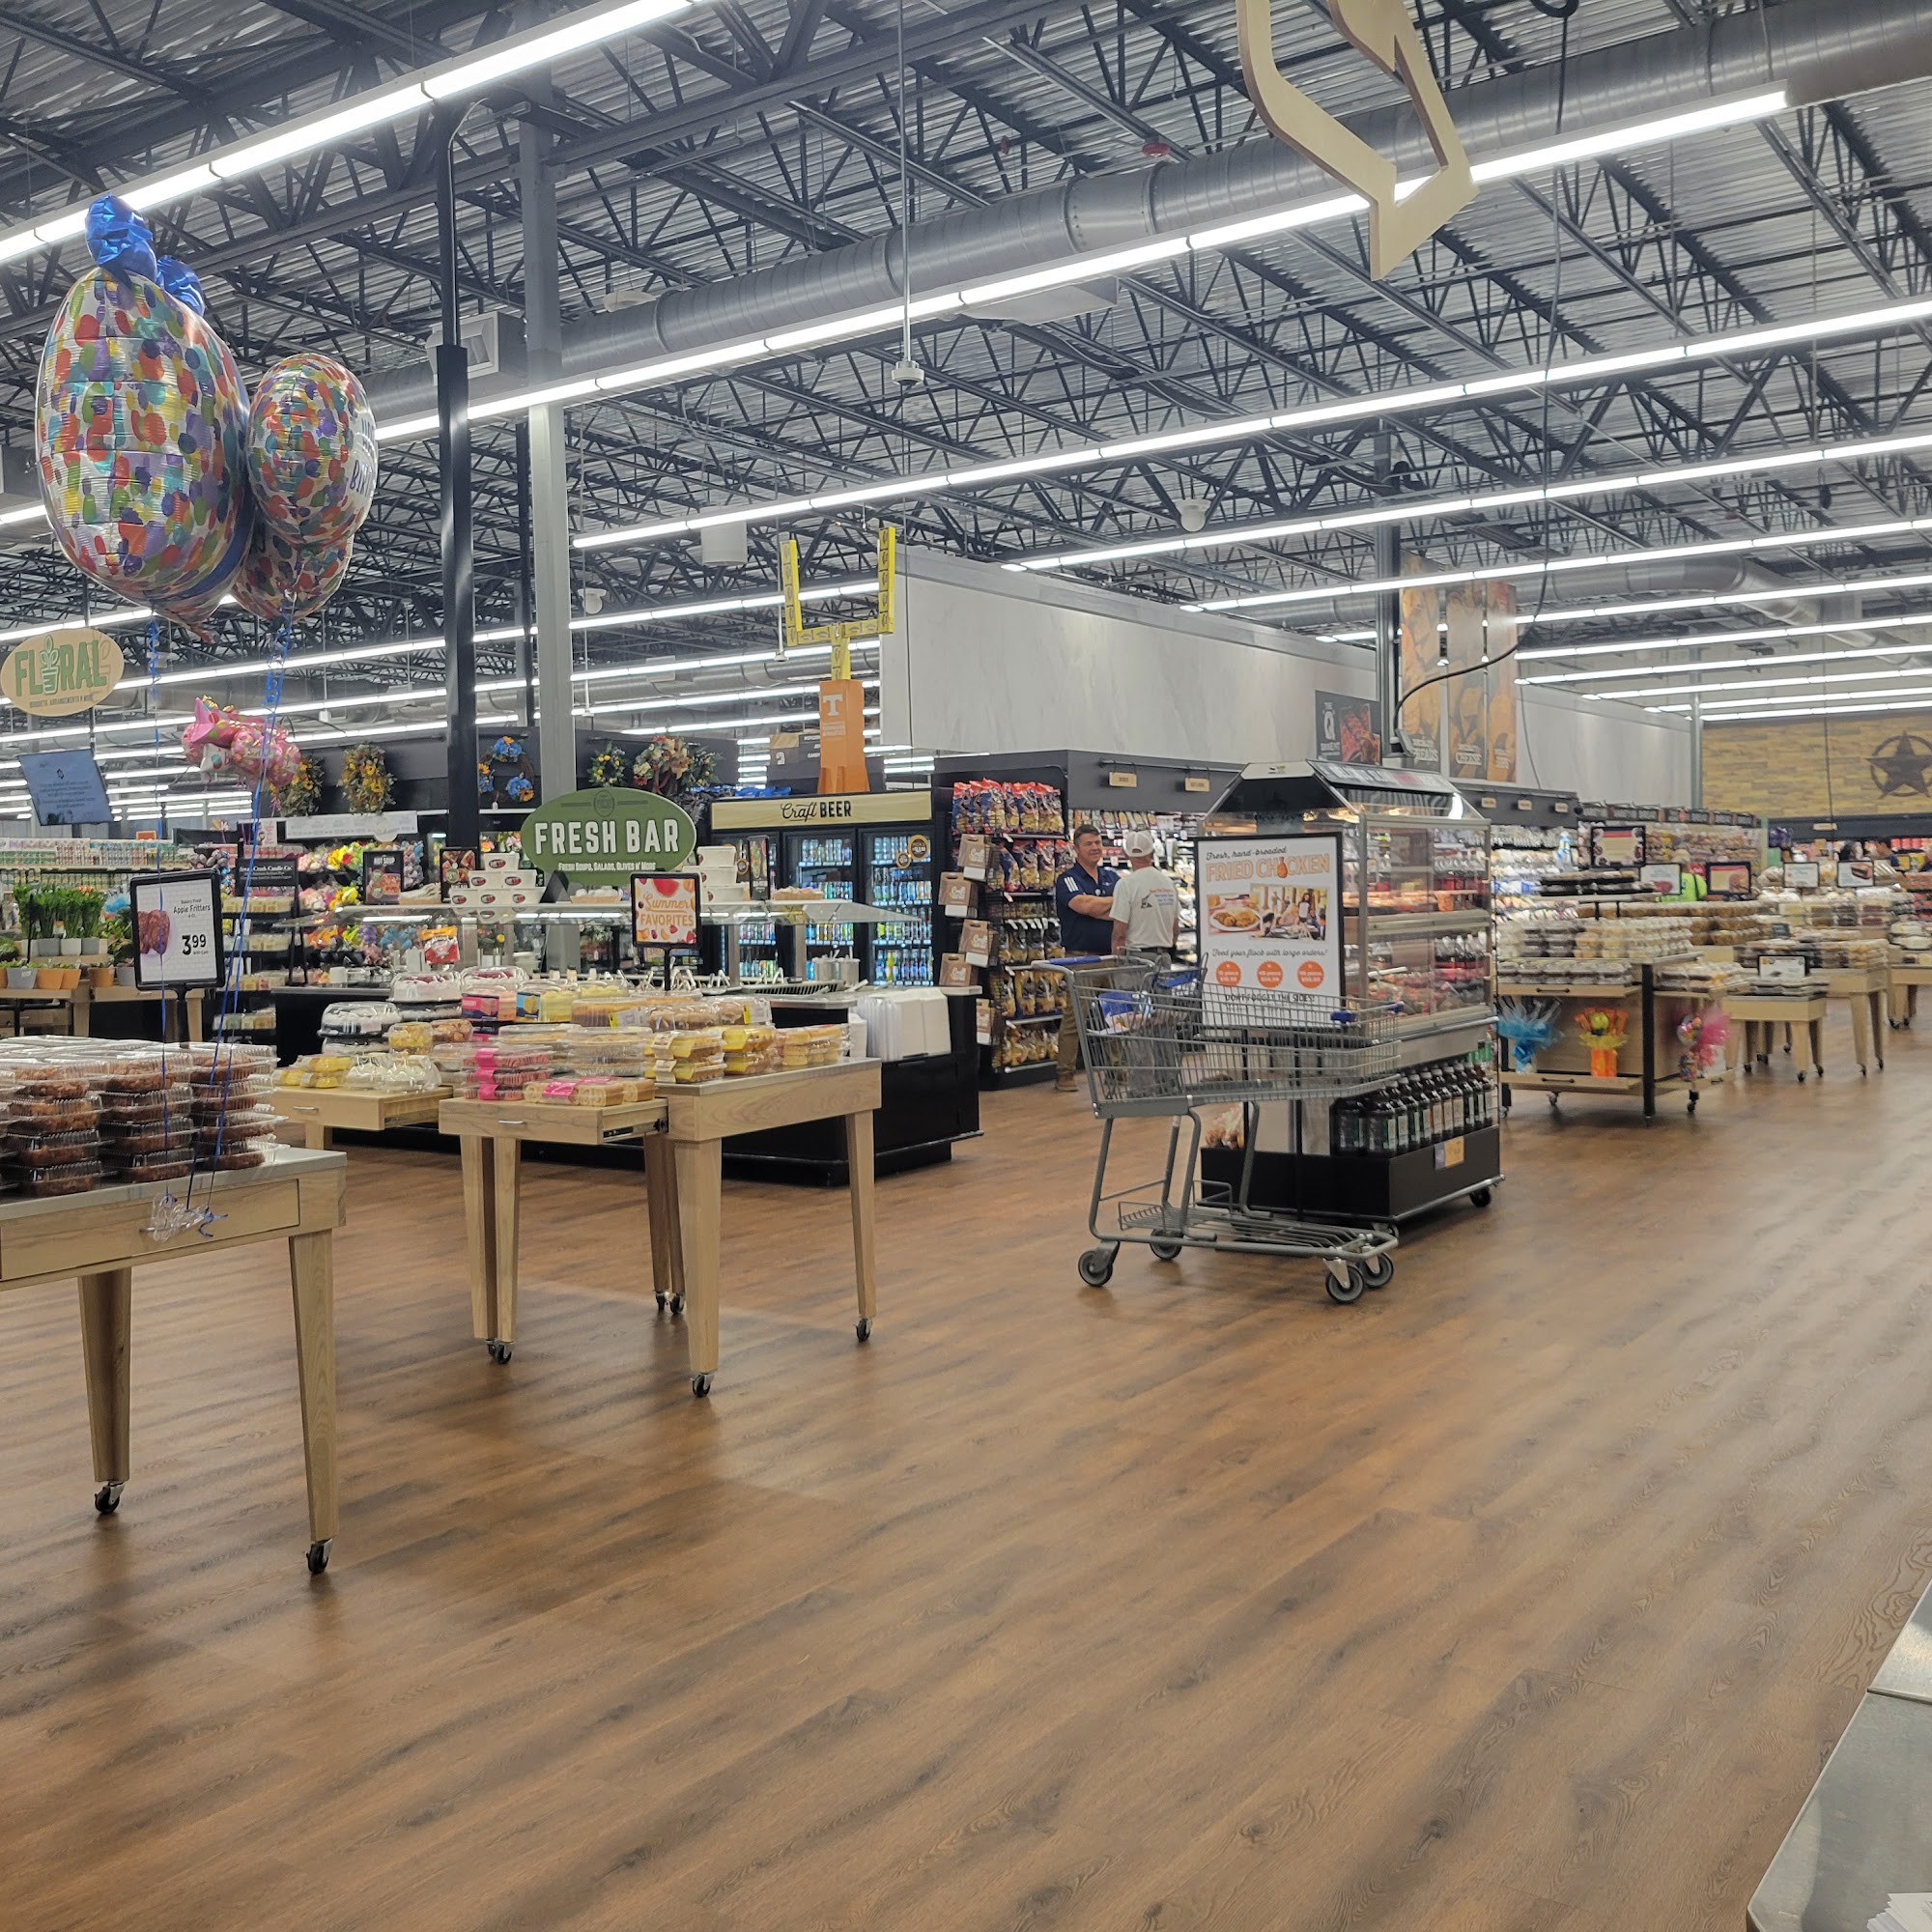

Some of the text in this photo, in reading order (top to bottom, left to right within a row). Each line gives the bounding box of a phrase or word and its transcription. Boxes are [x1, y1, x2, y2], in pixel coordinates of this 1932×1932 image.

[822, 694, 843, 717] T
[781, 800, 852, 822] Craft BEER
[534, 818, 679, 855] FRESH BAR
[1206, 853, 1330, 883] FRIED CHICKEN
[173, 904, 212, 915] Apple Fritters
[644, 893, 692, 911] Summer
[639, 914, 695, 927] FAVORITES
[1212, 949, 1229, 957] Feed
[1230, 950, 1247, 958] your
[1265, 948, 1281, 956] with
[1282, 949, 1301, 958] large
